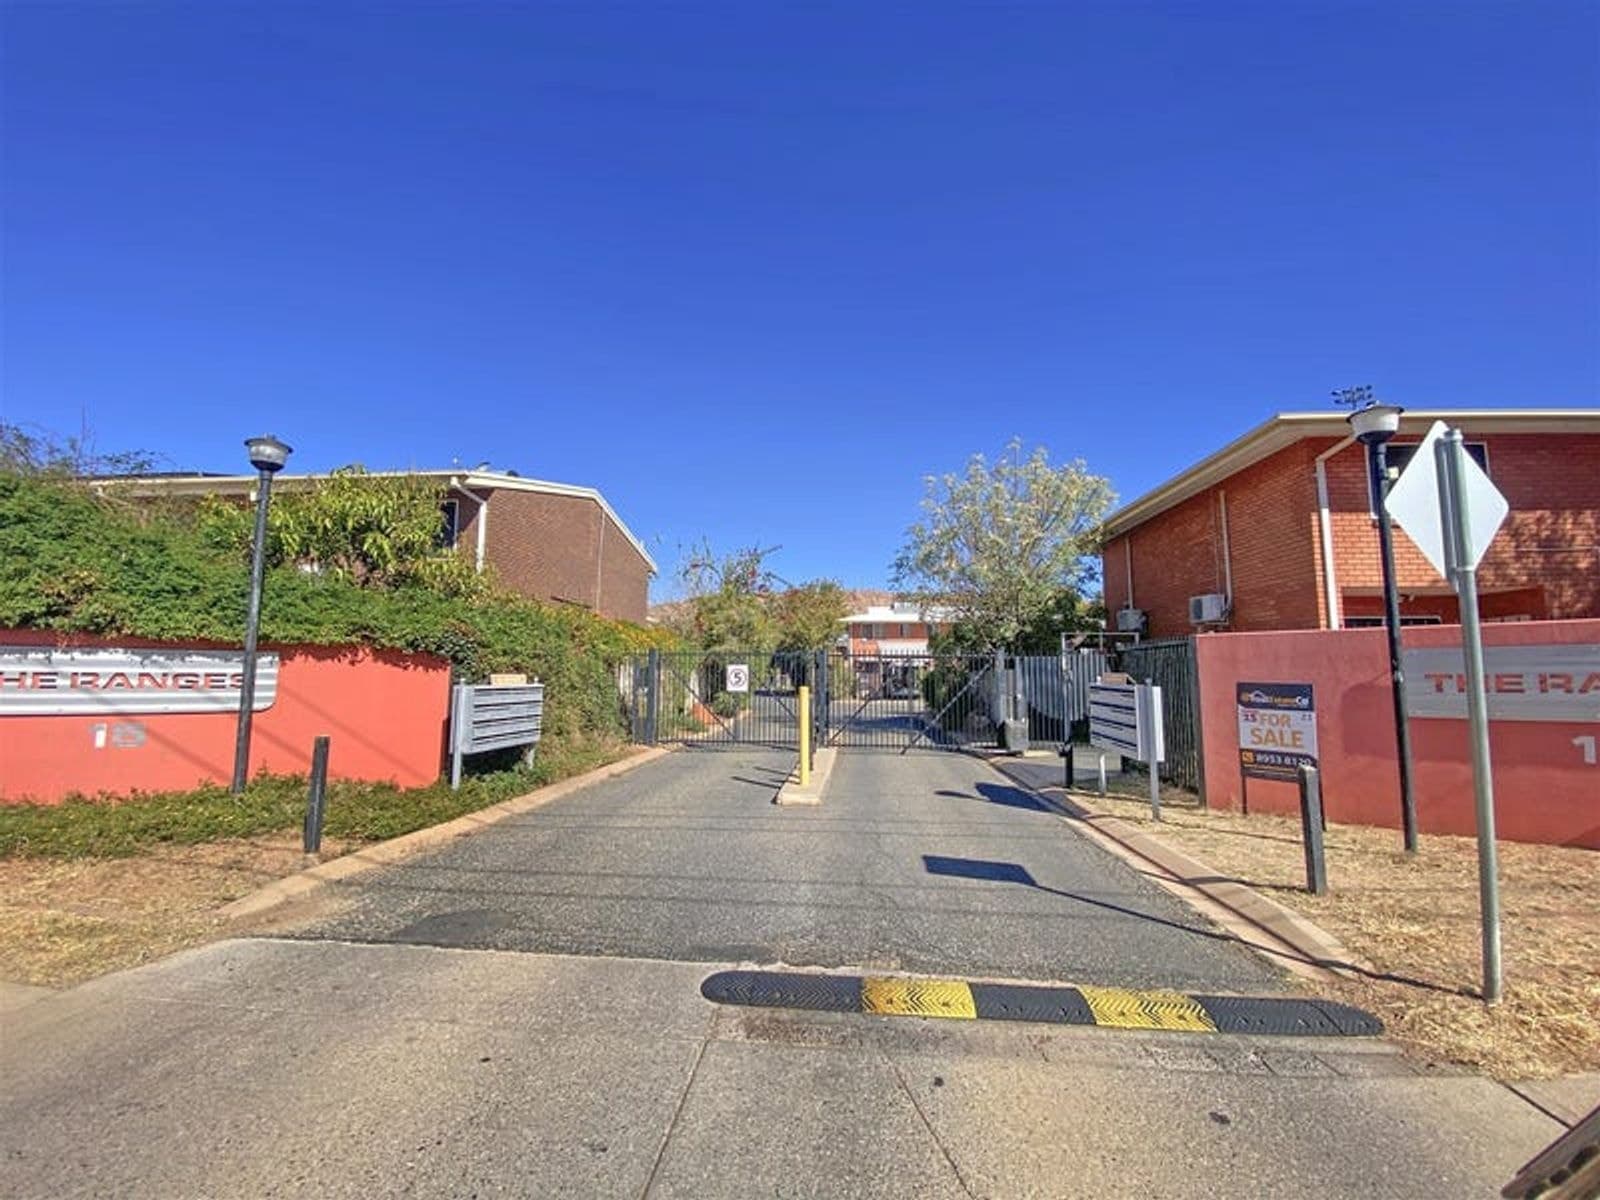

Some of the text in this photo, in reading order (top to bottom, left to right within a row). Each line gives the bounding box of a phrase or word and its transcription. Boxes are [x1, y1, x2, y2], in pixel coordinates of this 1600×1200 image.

[1260, 713, 1291, 728] FOR
[1250, 728, 1304, 748] SALE
[1572, 735, 1597, 765] 1
